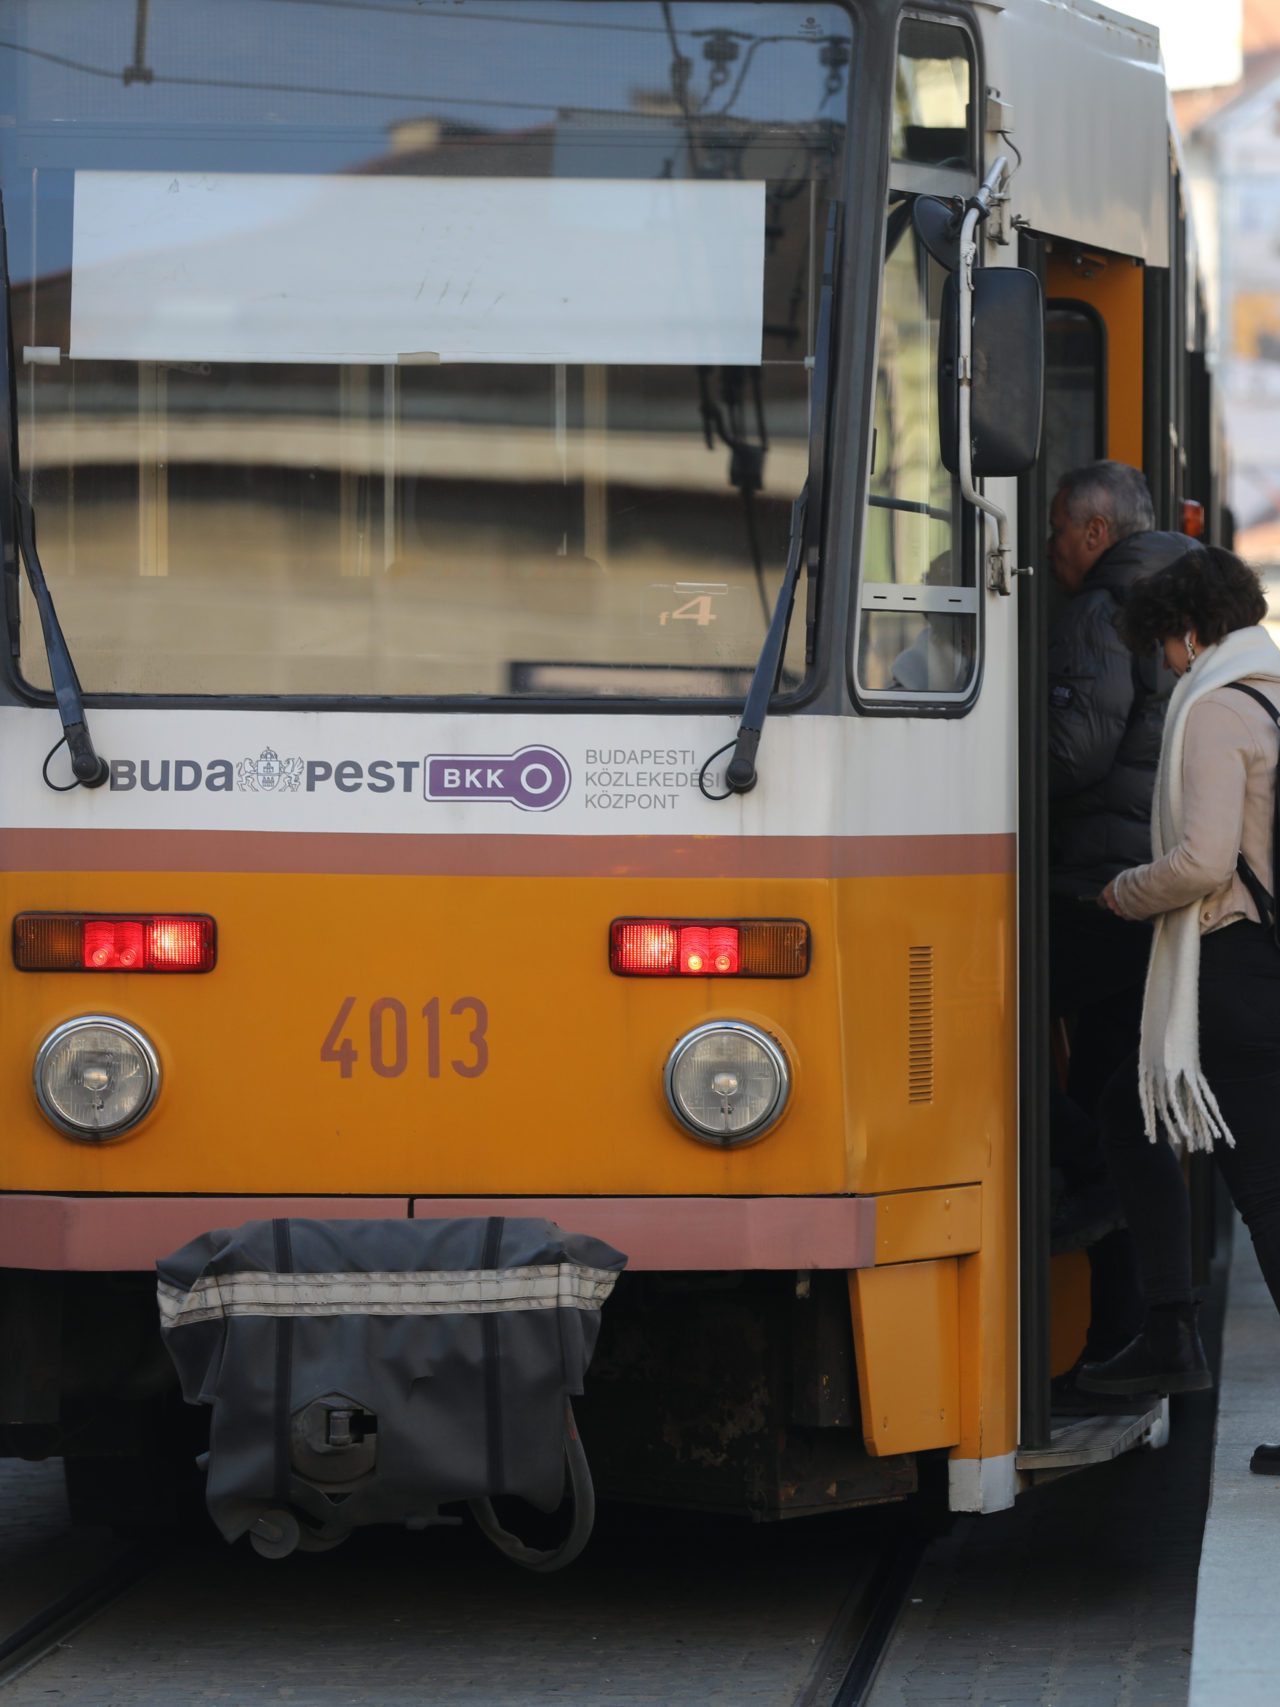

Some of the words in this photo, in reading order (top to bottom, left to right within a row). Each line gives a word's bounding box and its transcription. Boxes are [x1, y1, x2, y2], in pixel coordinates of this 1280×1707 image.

[585, 750, 695, 765] BUDAPESTI
[443, 768, 505, 788] BKK
[585, 770, 720, 788] KÖZLEKEDÉSI
[585, 792, 680, 809] KÖZPONT
[319, 996, 490, 1079] 4013
